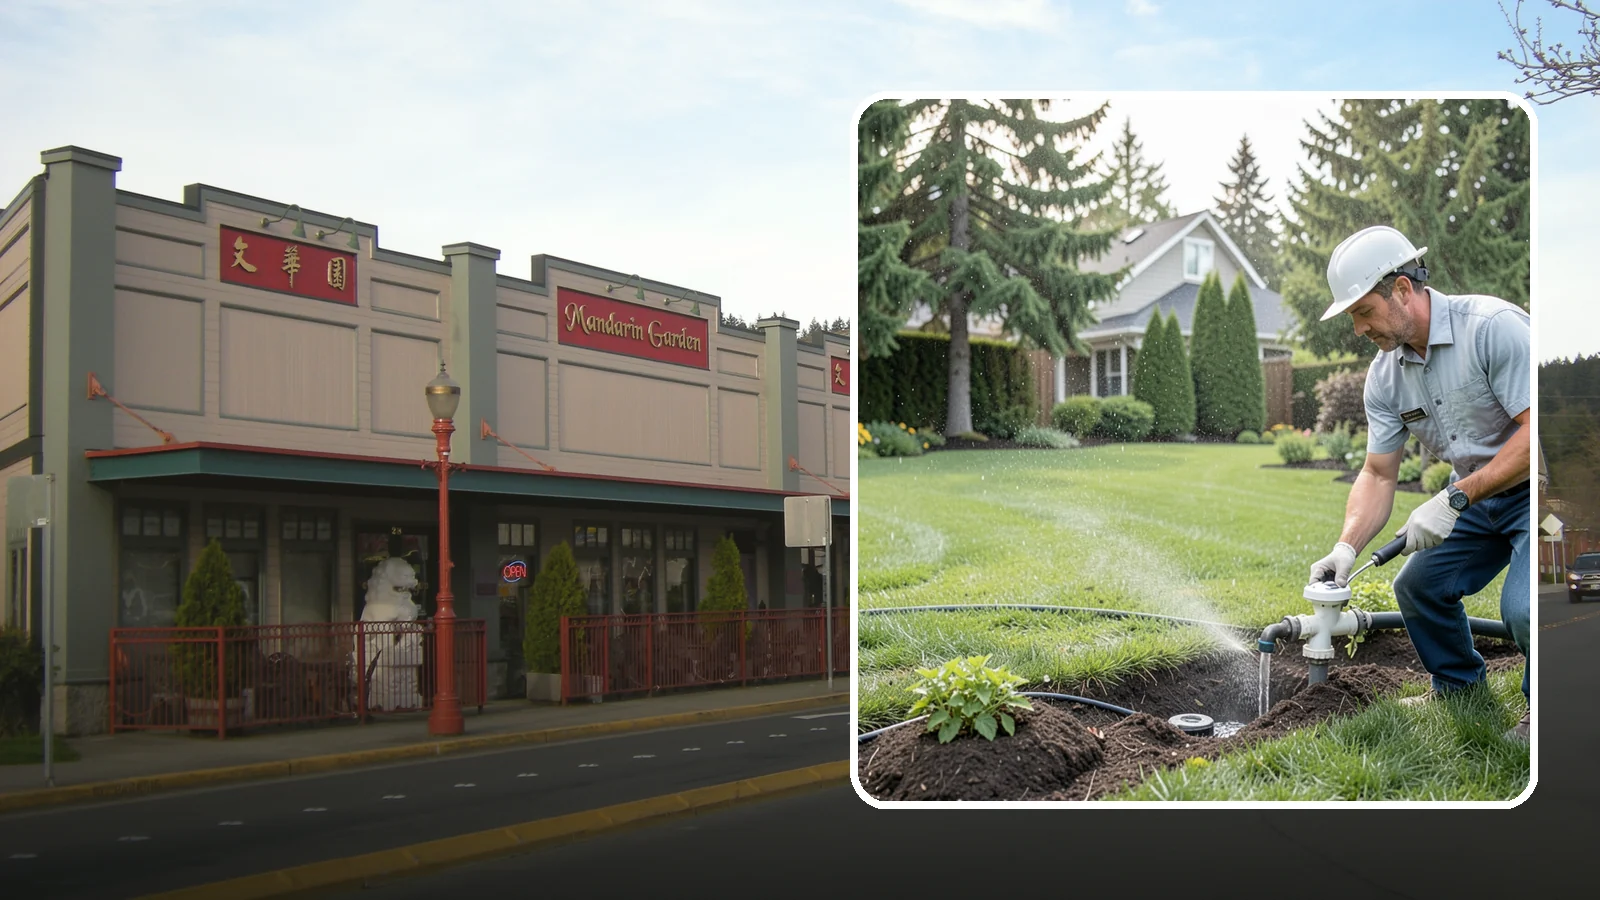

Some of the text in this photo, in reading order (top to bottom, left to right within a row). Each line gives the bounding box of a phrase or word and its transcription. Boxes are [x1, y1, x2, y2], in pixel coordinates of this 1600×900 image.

[231, 235, 346, 290] 文華園
[564, 302, 701, 352] Mandarin Garden
[503, 565, 526, 578] OPEN
